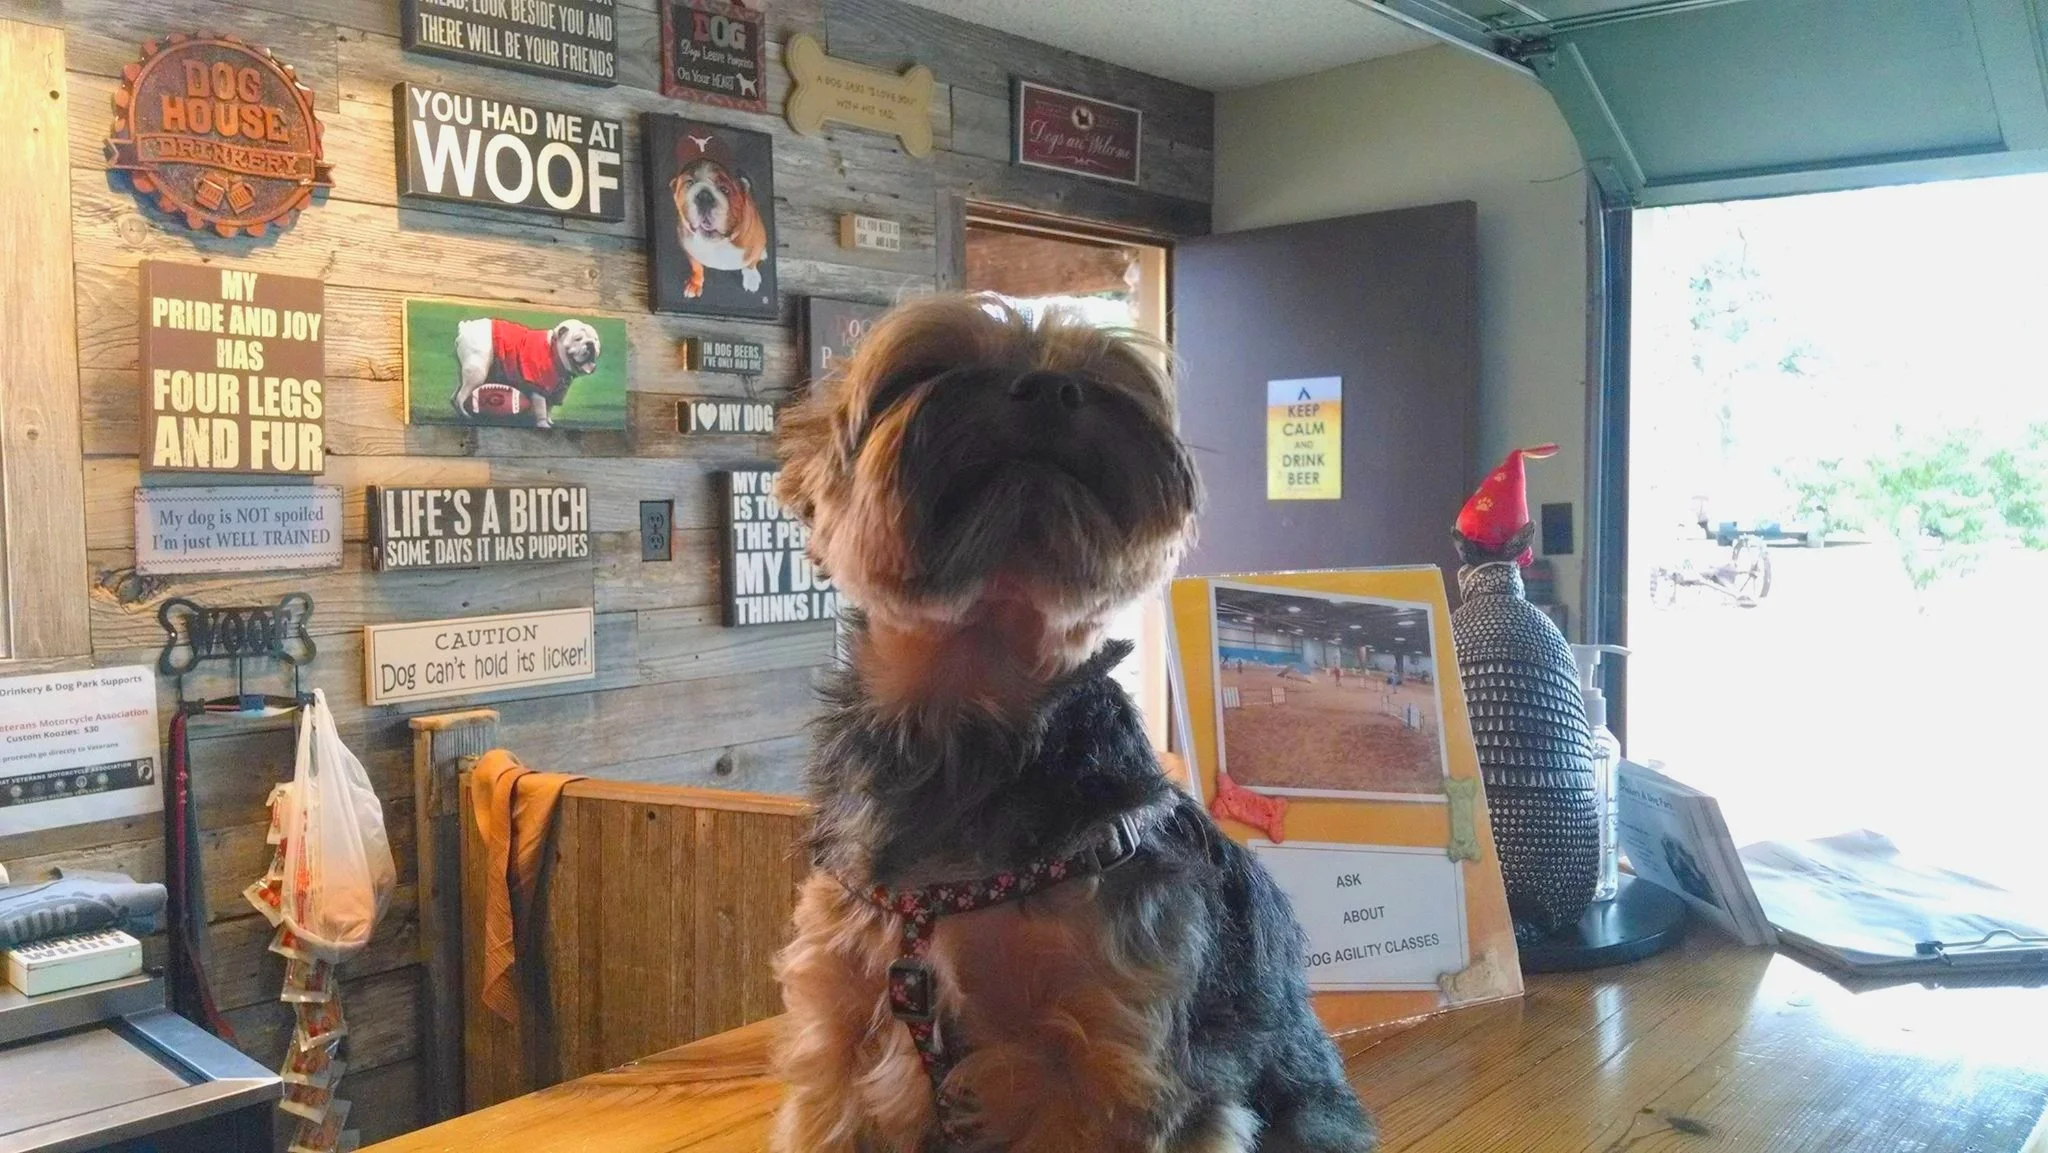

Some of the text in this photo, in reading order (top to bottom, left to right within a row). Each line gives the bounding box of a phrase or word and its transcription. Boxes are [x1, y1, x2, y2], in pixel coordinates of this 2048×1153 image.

[511, 0, 556, 29] BESIDE
[558, 5, 584, 35] YOU
[587, 12, 613, 42] AND
[692, 11, 746, 51] DOG
[420, 13, 614, 77] THERE WILL BE YOUR FRIENDS
[182, 59, 262, 104] DOG
[677, 66, 690, 81] On
[161, 94, 289, 144] HOUSE
[411, 87, 619, 149] YOU HAD ME AT
[1029, 119, 1064, 154] Dogs
[1087, 134, 1132, 160] Welcome
[156, 138, 297, 174] DRINKERY
[412, 119, 621, 214] WOOF
[221, 269, 258, 302] MY
[152, 297, 322, 342] PRIDE AND JOY
[216, 338, 265, 371] HAS
[704, 342, 712, 355] IN
[715, 343, 732, 357] DOG
[153, 368, 323, 420] FOUR LEGS
[690, 403, 774, 432] I MY DOG
[1288, 403, 1320, 418] KEEP
[153, 415, 323, 472] AND FUR
[1282, 421, 1325, 437] CALM
[1294, 440, 1314, 450] AND
[1282, 454, 1325, 468] DRINK
[732, 471, 758, 494] MY
[1287, 472, 1320, 485] BEER
[159, 506, 324, 531] My dog is NOT spoiled
[386, 487, 589, 538] LIFE'S A BITCH
[733, 495, 753, 520] IS
[755, 495, 779, 520] TO
[152, 528, 331, 555] I'm just WELL TRAINED
[387, 534, 589, 567] SOME DAYS IT HAS PUPPIES
[734, 521, 812, 550] THE PER
[735, 551, 784, 596] MY
[735, 593, 809, 625] THINKS
[812, 592, 820, 619] I
[187, 609, 292, 655] WOOF
[435, 625, 539, 651] CAUTION
[381, 637, 588, 694] Dog can't hold its licker!
[0, 675, 143, 697] Drinkery & Dog Park Supports
[0, 708, 149, 733] eterans Motorcycle Association
[6, 725, 100, 744] Custom Koozies: $30
[2, 753, 37, 763] proceeds
[48, 747, 76, 756] directly
[86, 742, 119, 751] Veterans
[1336, 873, 1362, 888] ASK
[1343, 905, 1385, 924] ABOUT
[1334, 942, 1382, 963] AGILITY
[1384, 933, 1440, 954] CLASSES
